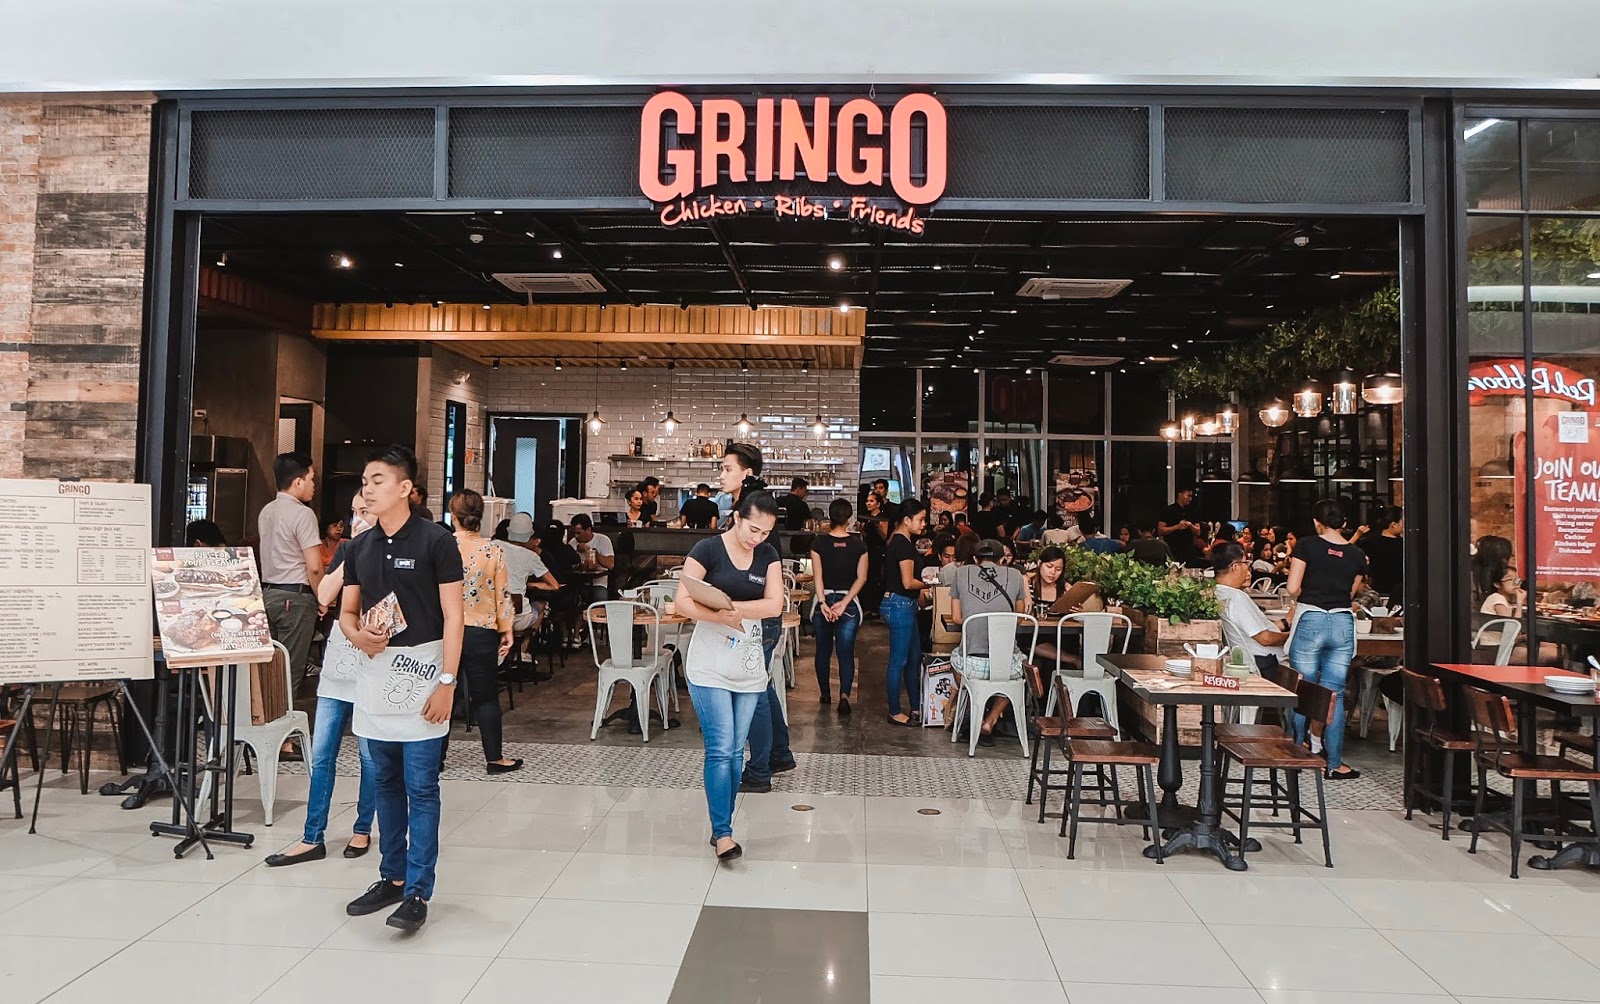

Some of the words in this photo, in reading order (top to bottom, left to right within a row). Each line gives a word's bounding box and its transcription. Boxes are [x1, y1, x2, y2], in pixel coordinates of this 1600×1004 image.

[639, 91, 947, 205] GRINGO
[660, 195, 747, 226] Chicken
[775, 195, 823, 218] Ribs
[850, 197, 925, 233] Friends
[1534, 457, 1574, 480] JOIN
[58, 484, 90, 495] GRINGO
[183, 559, 204, 567] YOUR
[207, 559, 241, 567] PLEASURE
[214, 551, 231, 560] FOR
[391, 654, 437, 681] GRINGO
[1204, 675, 1237, 689] RESERVED
